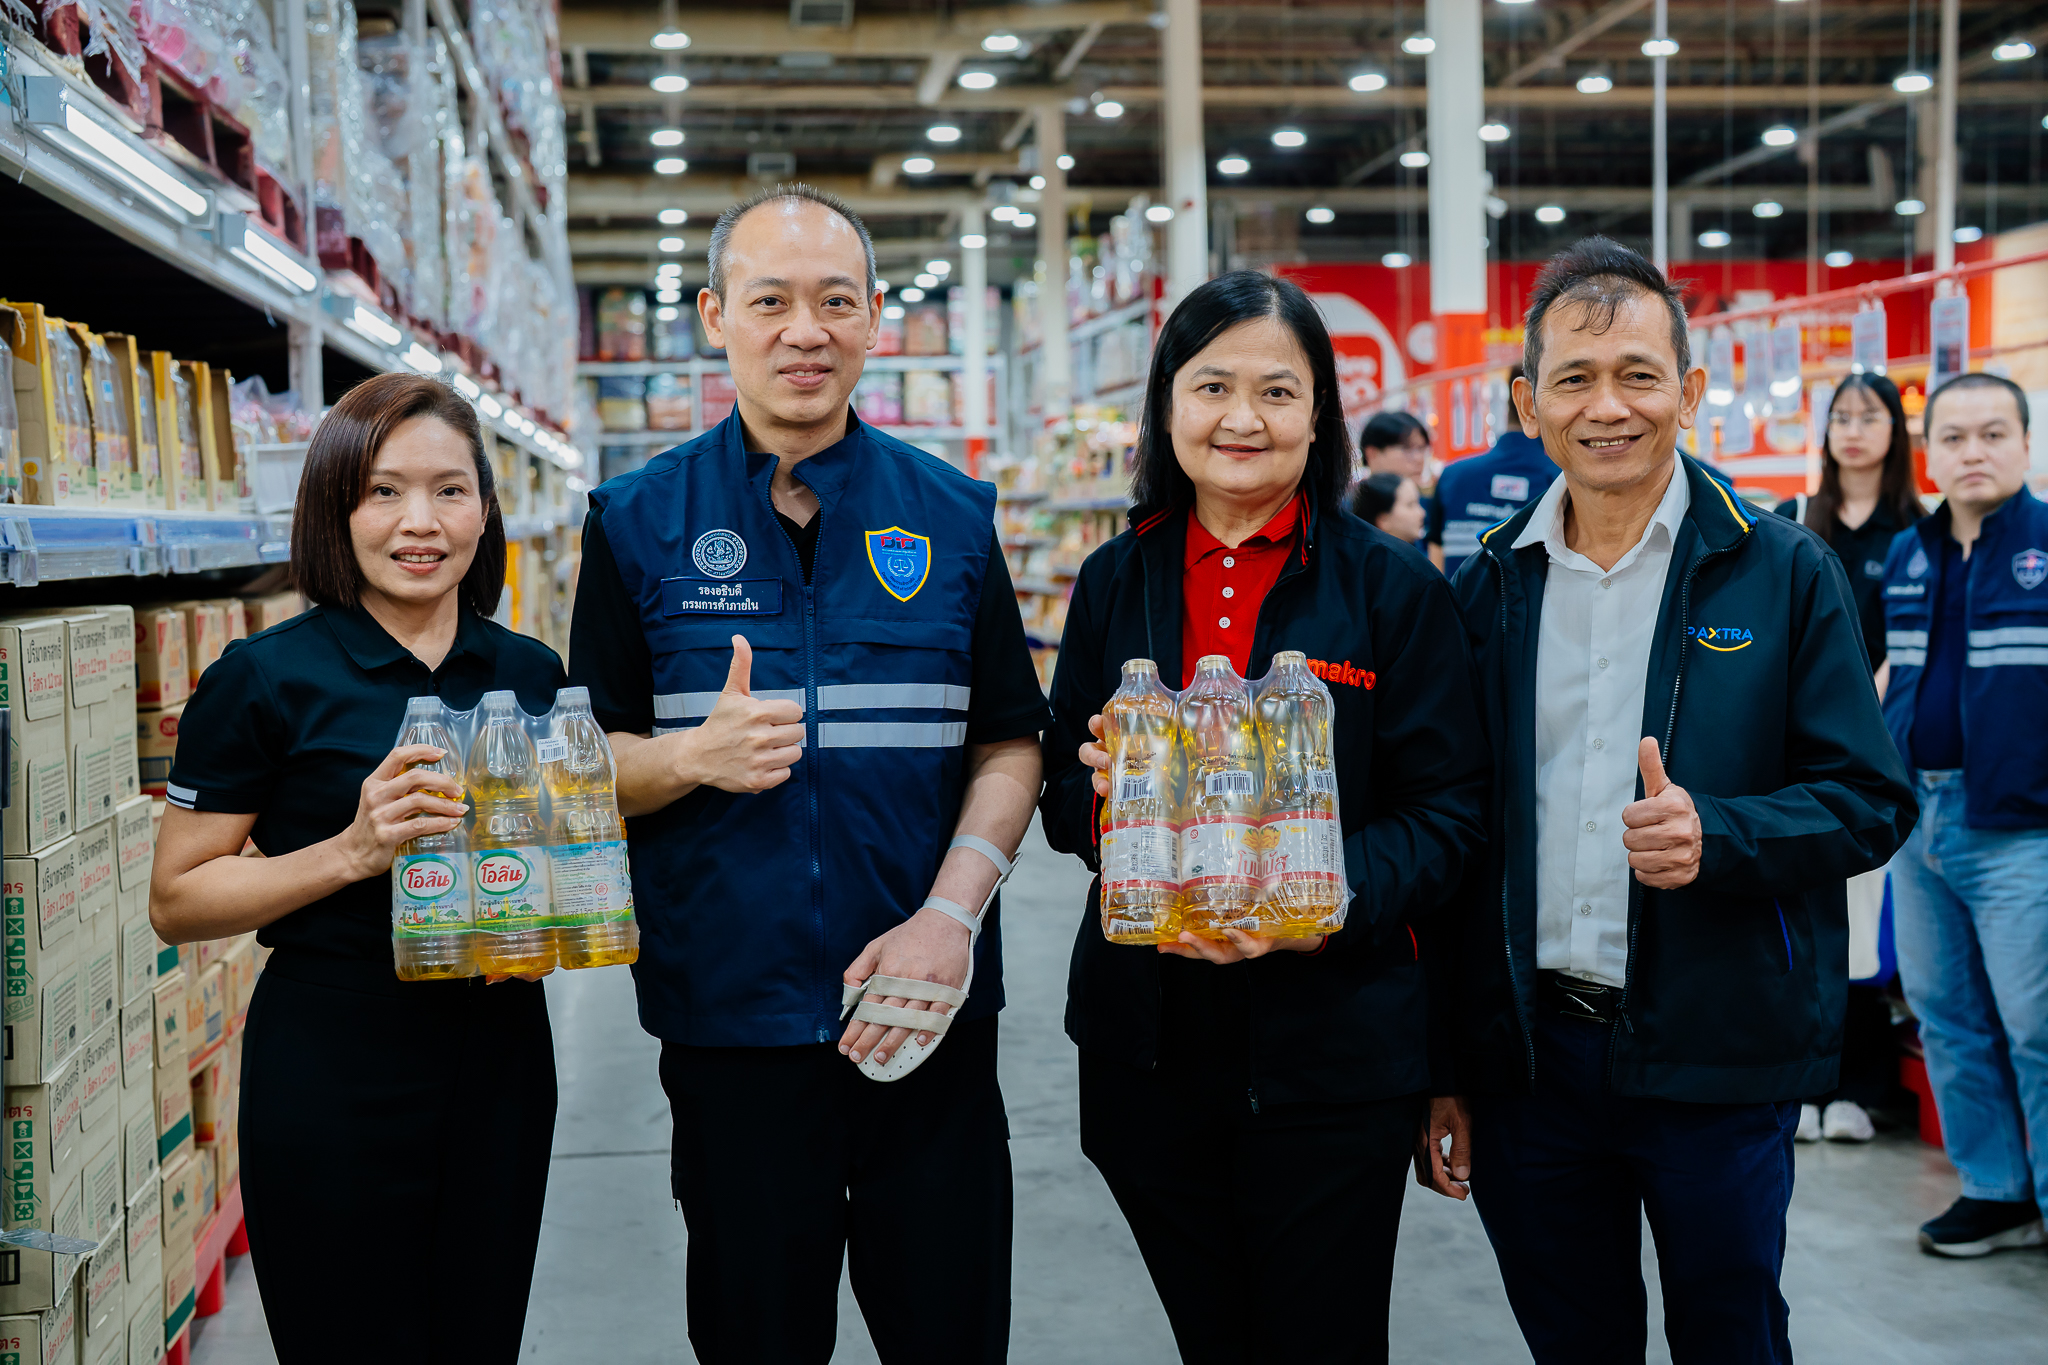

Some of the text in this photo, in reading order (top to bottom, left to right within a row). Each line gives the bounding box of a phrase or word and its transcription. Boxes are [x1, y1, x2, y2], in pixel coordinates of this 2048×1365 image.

[698, 583, 742, 596] รองอธิบดี
[682, 597, 759, 611] กรมการค้าภายใน
[1688, 626, 1754, 641] PAXTRA
[1306, 658, 1376, 690] makro
[407, 868, 450, 889] โอลีน
[481, 863, 523, 884] โอลีน
